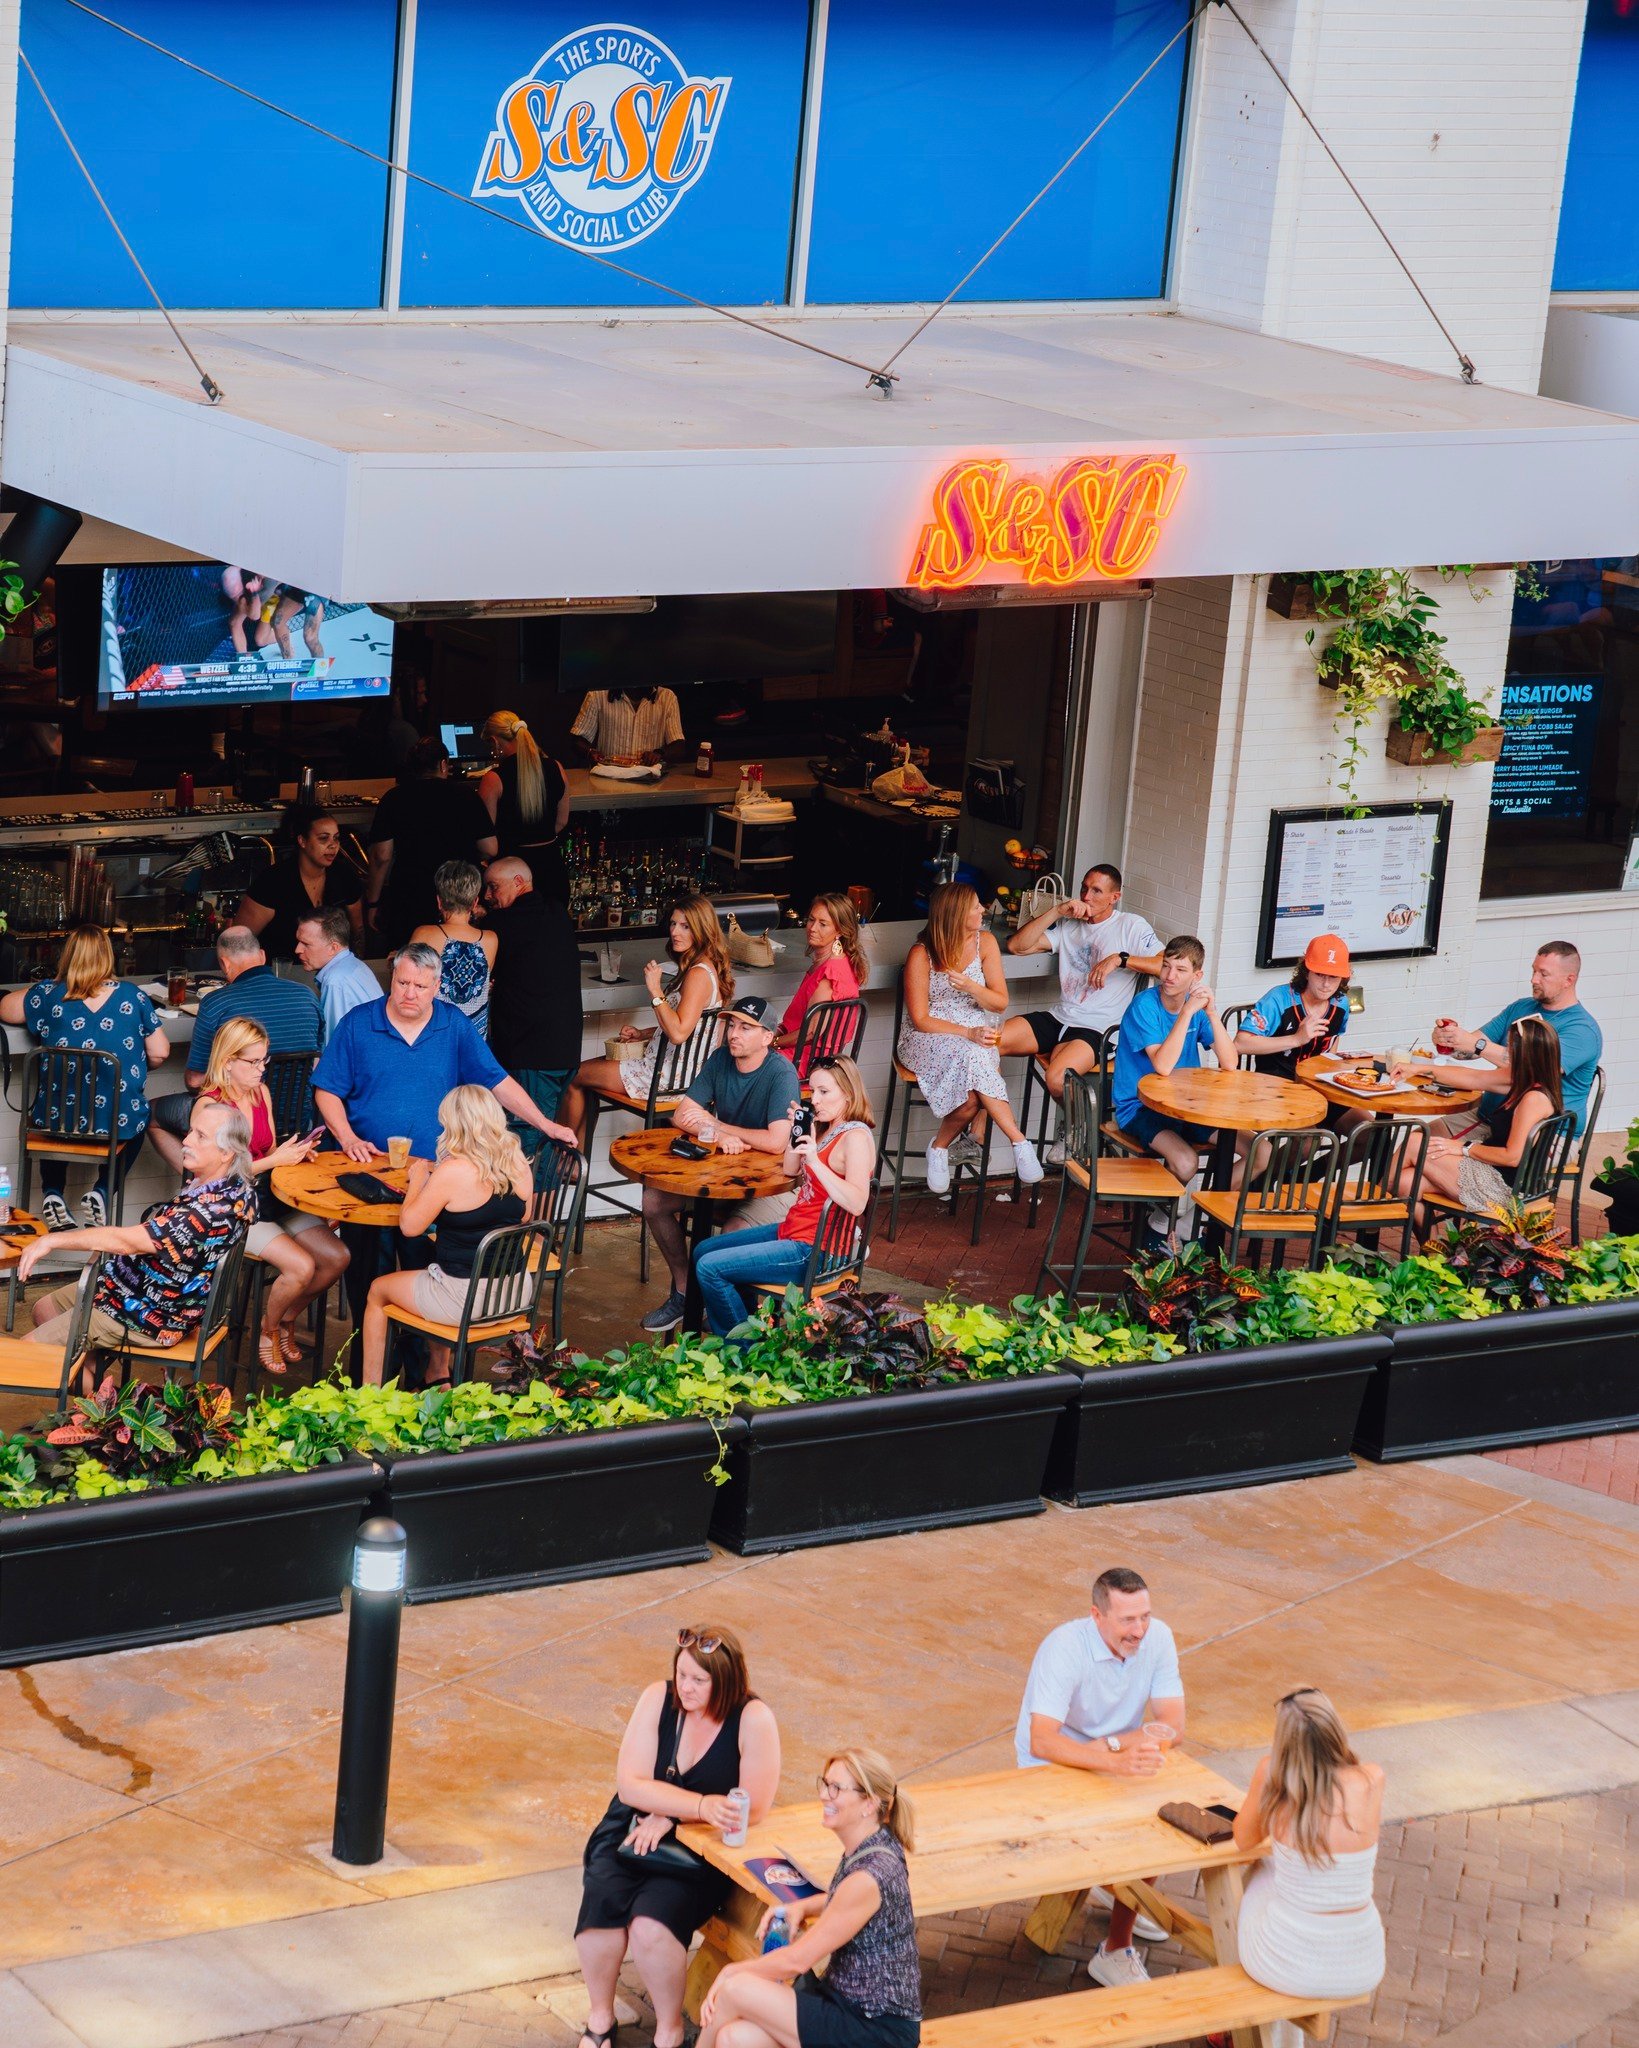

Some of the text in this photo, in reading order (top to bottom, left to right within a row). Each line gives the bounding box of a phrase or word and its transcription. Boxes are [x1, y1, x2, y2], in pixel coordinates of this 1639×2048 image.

[555, 36, 662, 77] THE SPORTS
[481, 80, 724, 188] S&SC
[526, 180, 669, 243] AND SOCIAL CLUB
[906, 453, 1187, 589] S&SC
[238, 663, 257, 673] 4:38
[1523, 797, 1551, 805] SOCIAL
